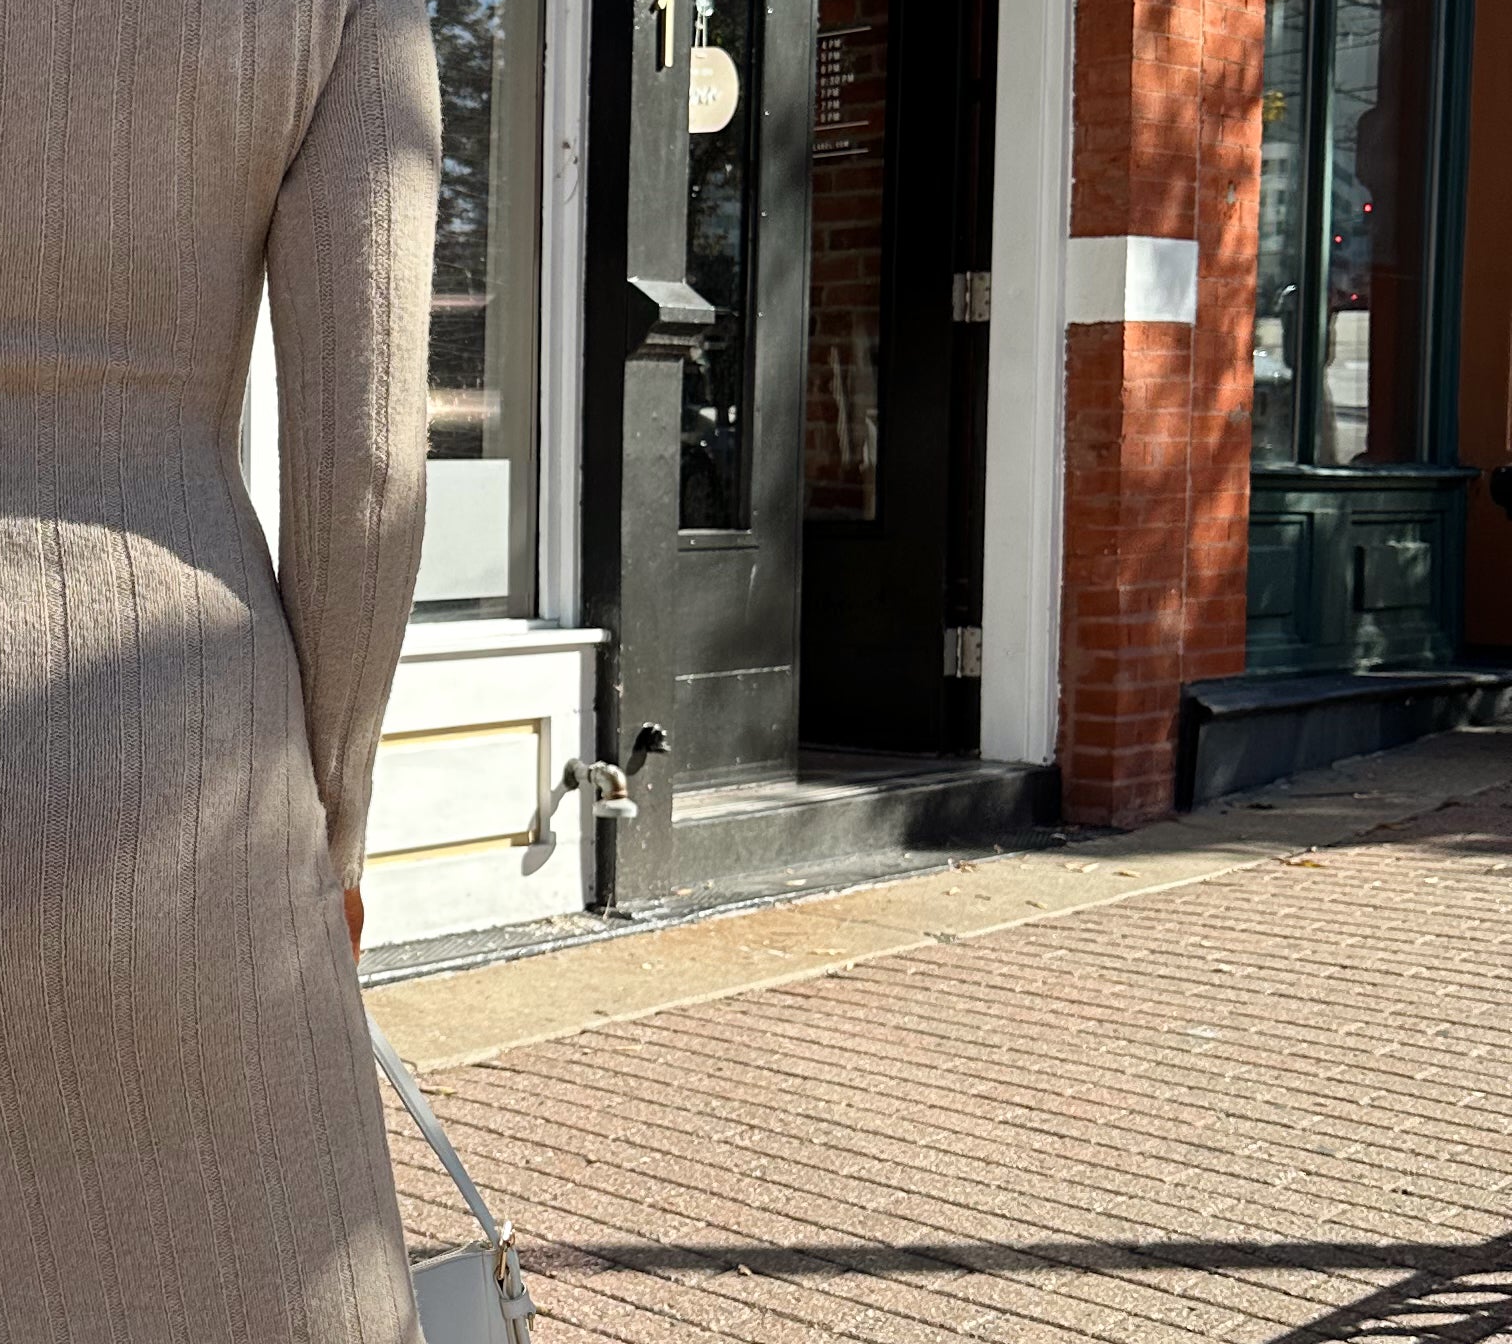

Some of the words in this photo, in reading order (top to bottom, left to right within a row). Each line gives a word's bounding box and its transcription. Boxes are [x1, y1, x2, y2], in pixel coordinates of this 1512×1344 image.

[828, 39, 841, 49] PM
[828, 51, 841, 61] PM
[827, 63, 840, 74] PM
[841, 74, 855, 84] PM
[827, 88, 840, 98] PM
[827, 100, 840, 110] PM
[827, 112, 840, 122] PM
